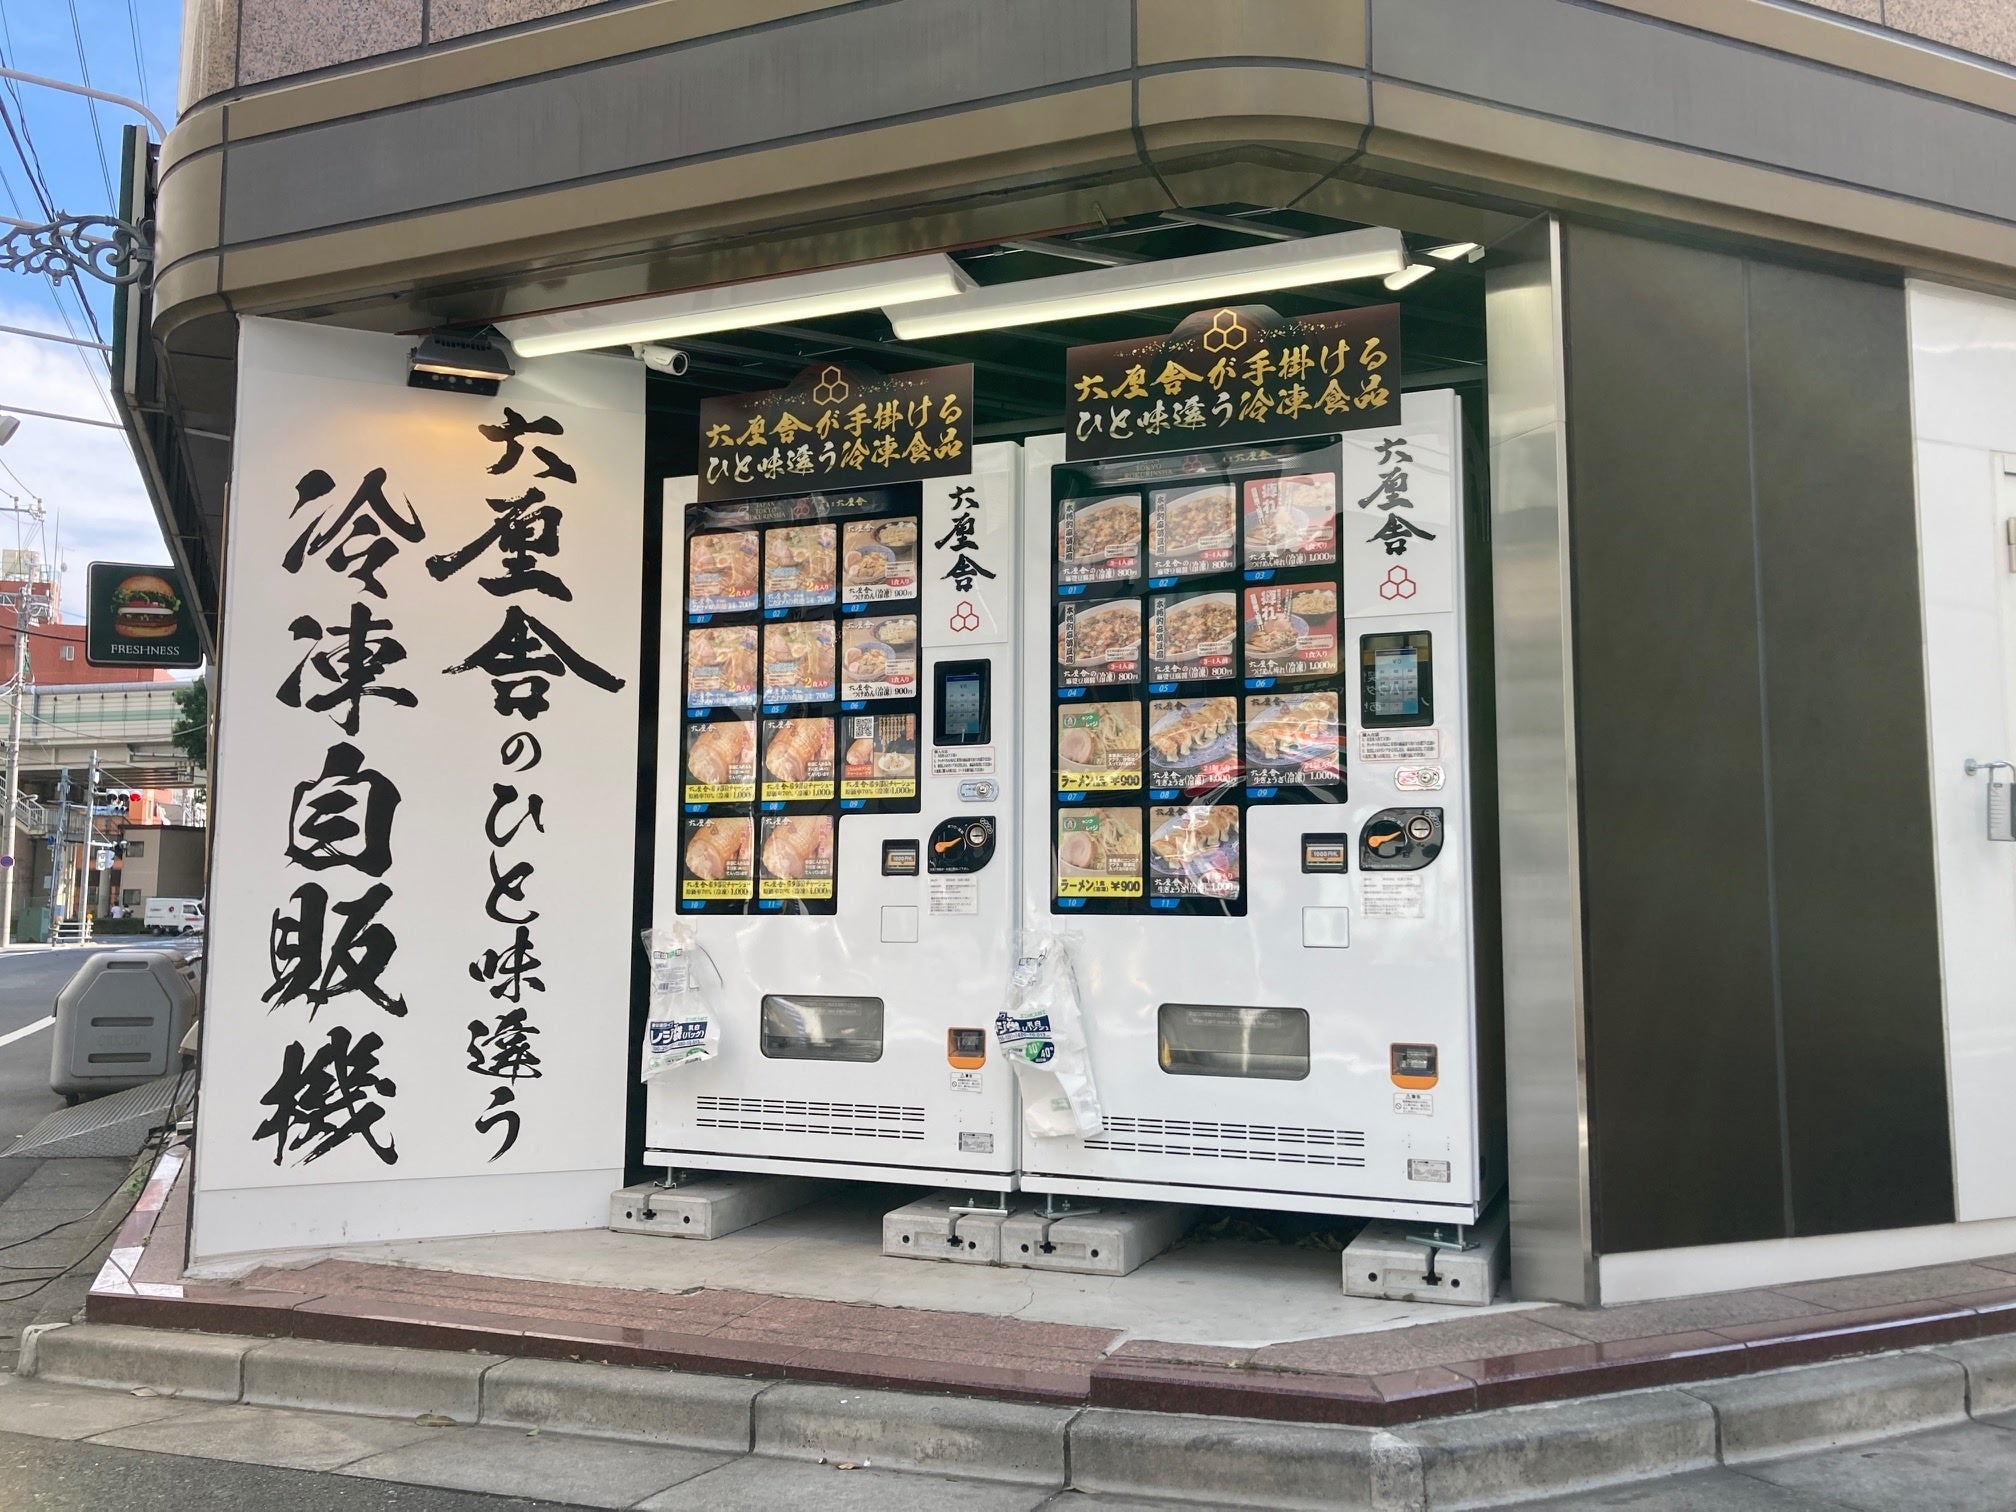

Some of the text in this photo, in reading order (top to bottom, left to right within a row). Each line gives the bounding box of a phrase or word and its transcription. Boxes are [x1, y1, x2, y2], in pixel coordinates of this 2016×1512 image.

[1074, 336, 1389, 403] 六厘舎が手掛ける
[1075, 373, 1391, 442] ひと味違う冷凍食品
[705, 393, 963, 448] 六厘舎が手掛ける
[706, 427, 964, 485] ひと味違う冷凍食品
[1357, 437, 1437, 557] 六厘舎
[836, 496, 868, 507] 六厘舎
[934, 485, 997, 593] 六厘舎
[1255, 571, 1265, 579] 03
[1158, 579, 1169, 587] 02
[1067, 586, 1077, 594] 01
[850, 604, 860, 612] 03
[696, 615, 705, 623] 01
[110, 643, 180, 657] FRESHNESS
[1255, 679, 1266, 687] 06
[1158, 684, 1169, 692] 05
[1067, 689, 1077, 697] 04
[771, 705, 780, 713] 05
[850, 701, 859, 710] 06
[1110, 774, 1140, 786] ¥900
[425, 406, 626, 1164] 六厘舎のひと味違う
[1067, 793, 1077, 801] 07
[1159, 791, 1170, 799] 08
[1256, 789, 1268, 797] 09
[252, 466, 426, 1168] 冷凍自販機
[1061, 878, 1094, 892] ラーメン
[1110, 880, 1141, 892] ¥900
[1068, 899, 1077, 907] 10
[1161, 899, 1170, 907] 11
